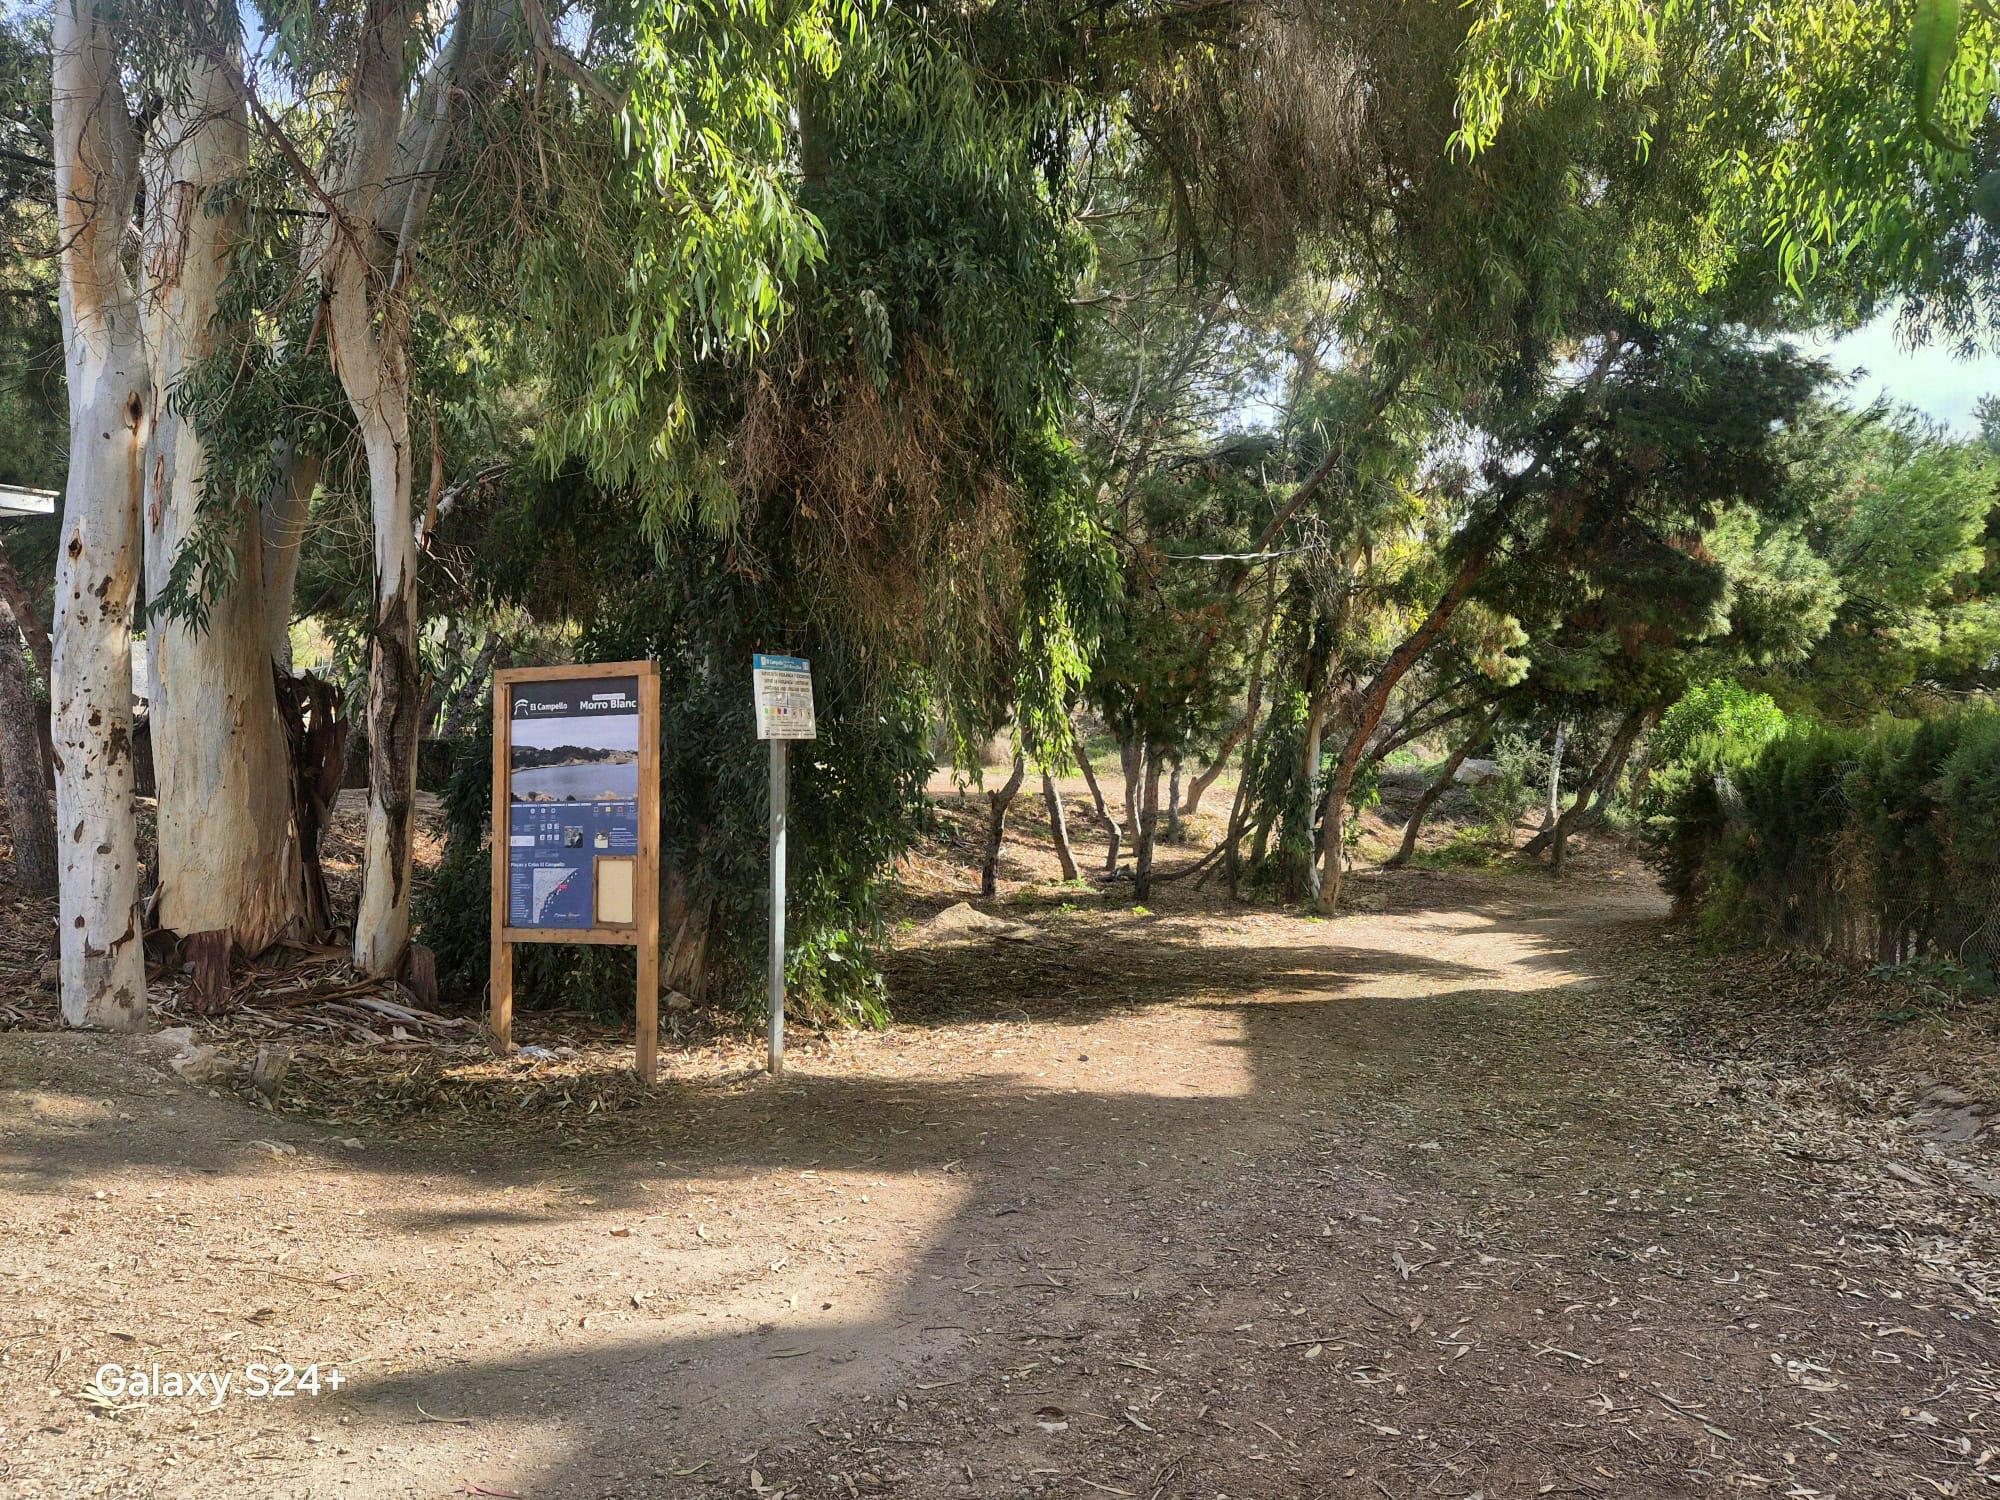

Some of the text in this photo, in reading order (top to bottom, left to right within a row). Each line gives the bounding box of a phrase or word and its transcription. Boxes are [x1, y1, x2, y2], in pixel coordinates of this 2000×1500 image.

[530, 702, 568, 712] El Campello
[580, 699, 637, 710] Morro Blanc
